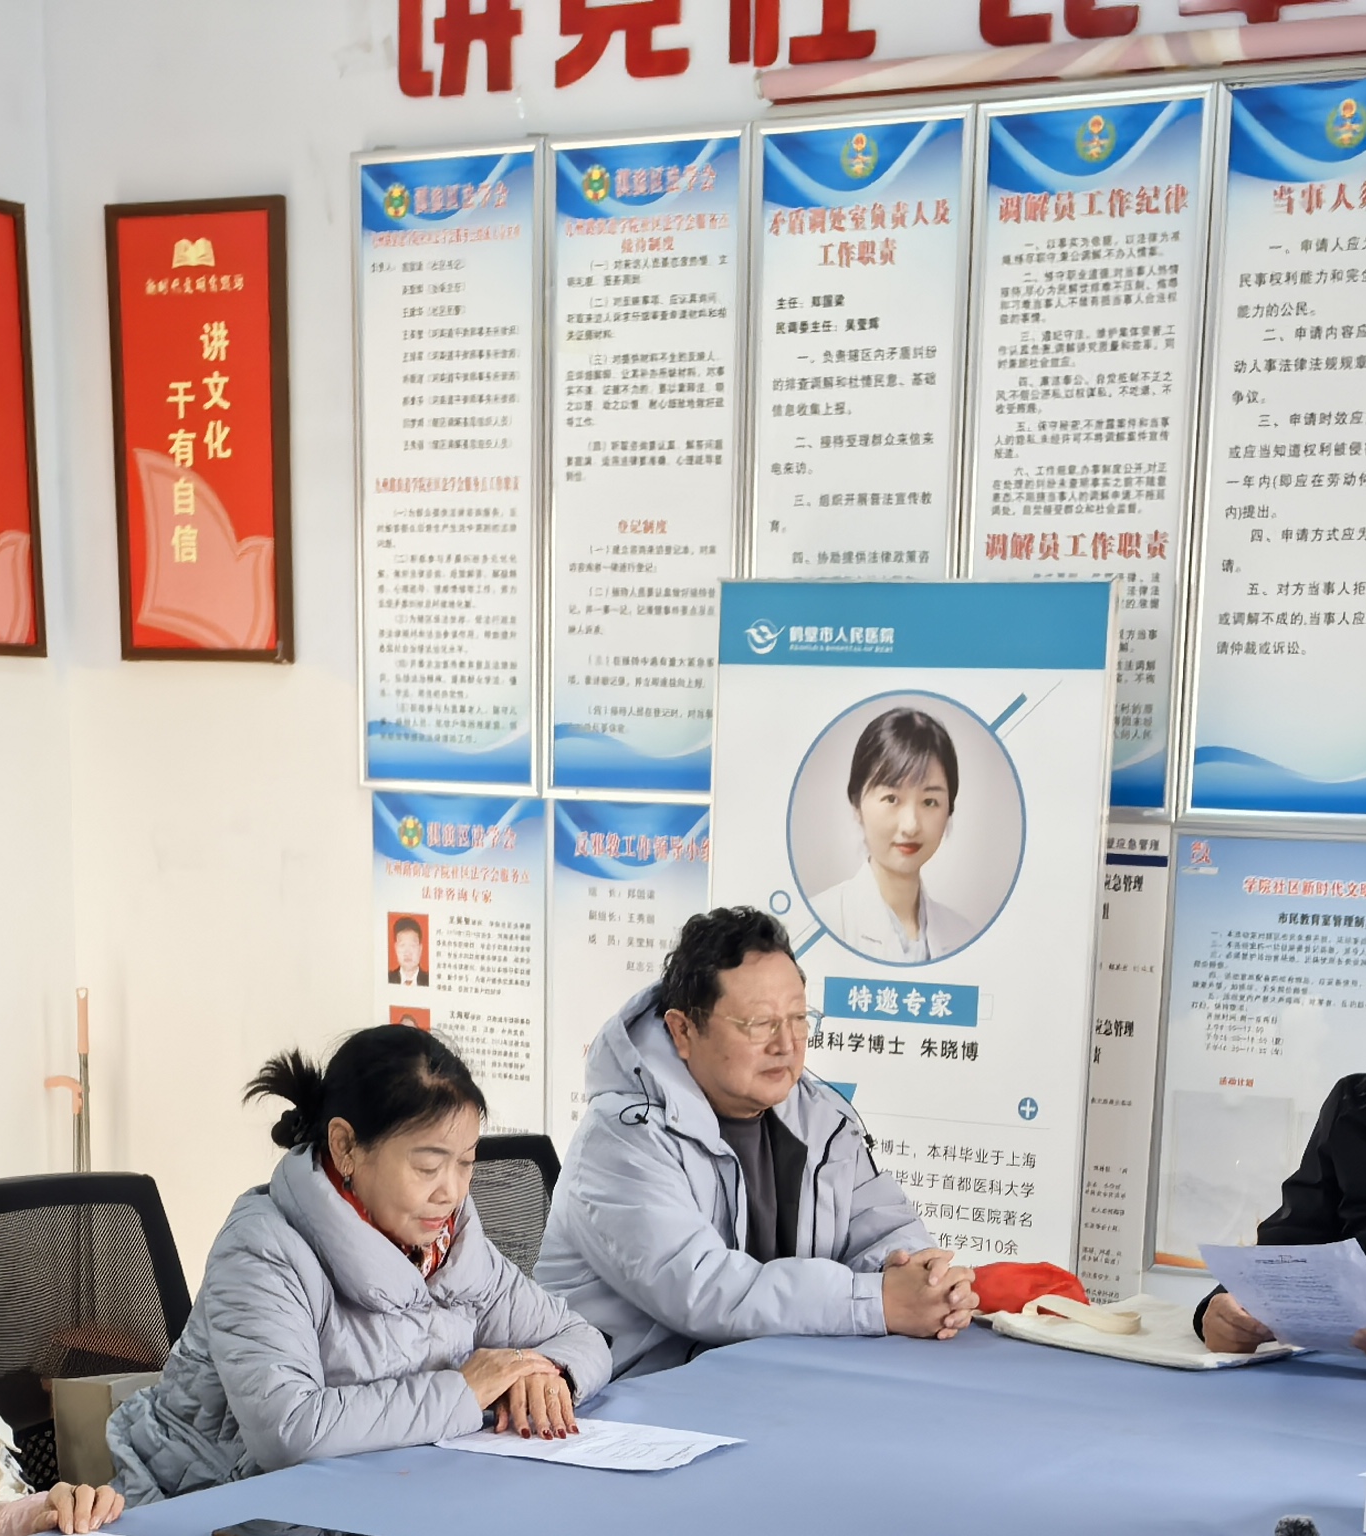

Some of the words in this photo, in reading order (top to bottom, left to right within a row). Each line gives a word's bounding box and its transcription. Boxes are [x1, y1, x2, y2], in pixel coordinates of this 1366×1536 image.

[768, 198, 952, 237] 矛盾调处室负责人及
[999, 184, 1189, 225] 调解员工作纪律
[818, 237, 898, 269] 工作职责
[1236, 301, 1316, 319] 能力的公民。
[200, 321, 232, 460] 讲文化
[1232, 389, 1266, 405] 争议。
[166, 381, 198, 564] 干有自信
[985, 529, 1170, 561] 调解员工作职责
[789, 626, 895, 644] 鹤壁市人民医院
[1216, 641, 1307, 656] 请仲裁或诉讼。
[422, 887, 492, 904] 法律咨询专家
[848, 985, 954, 1017] 特邀专家
[807, 1031, 906, 1056] 眼科学博士
[920, 1037, 980, 1062] 朱晓博
[1218, 1076, 1255, 1088] 活动计划
[880, 1169, 1035, 1197] 毕业于首都医科大学
[929, 1232, 1019, 1256] 作学习10余
